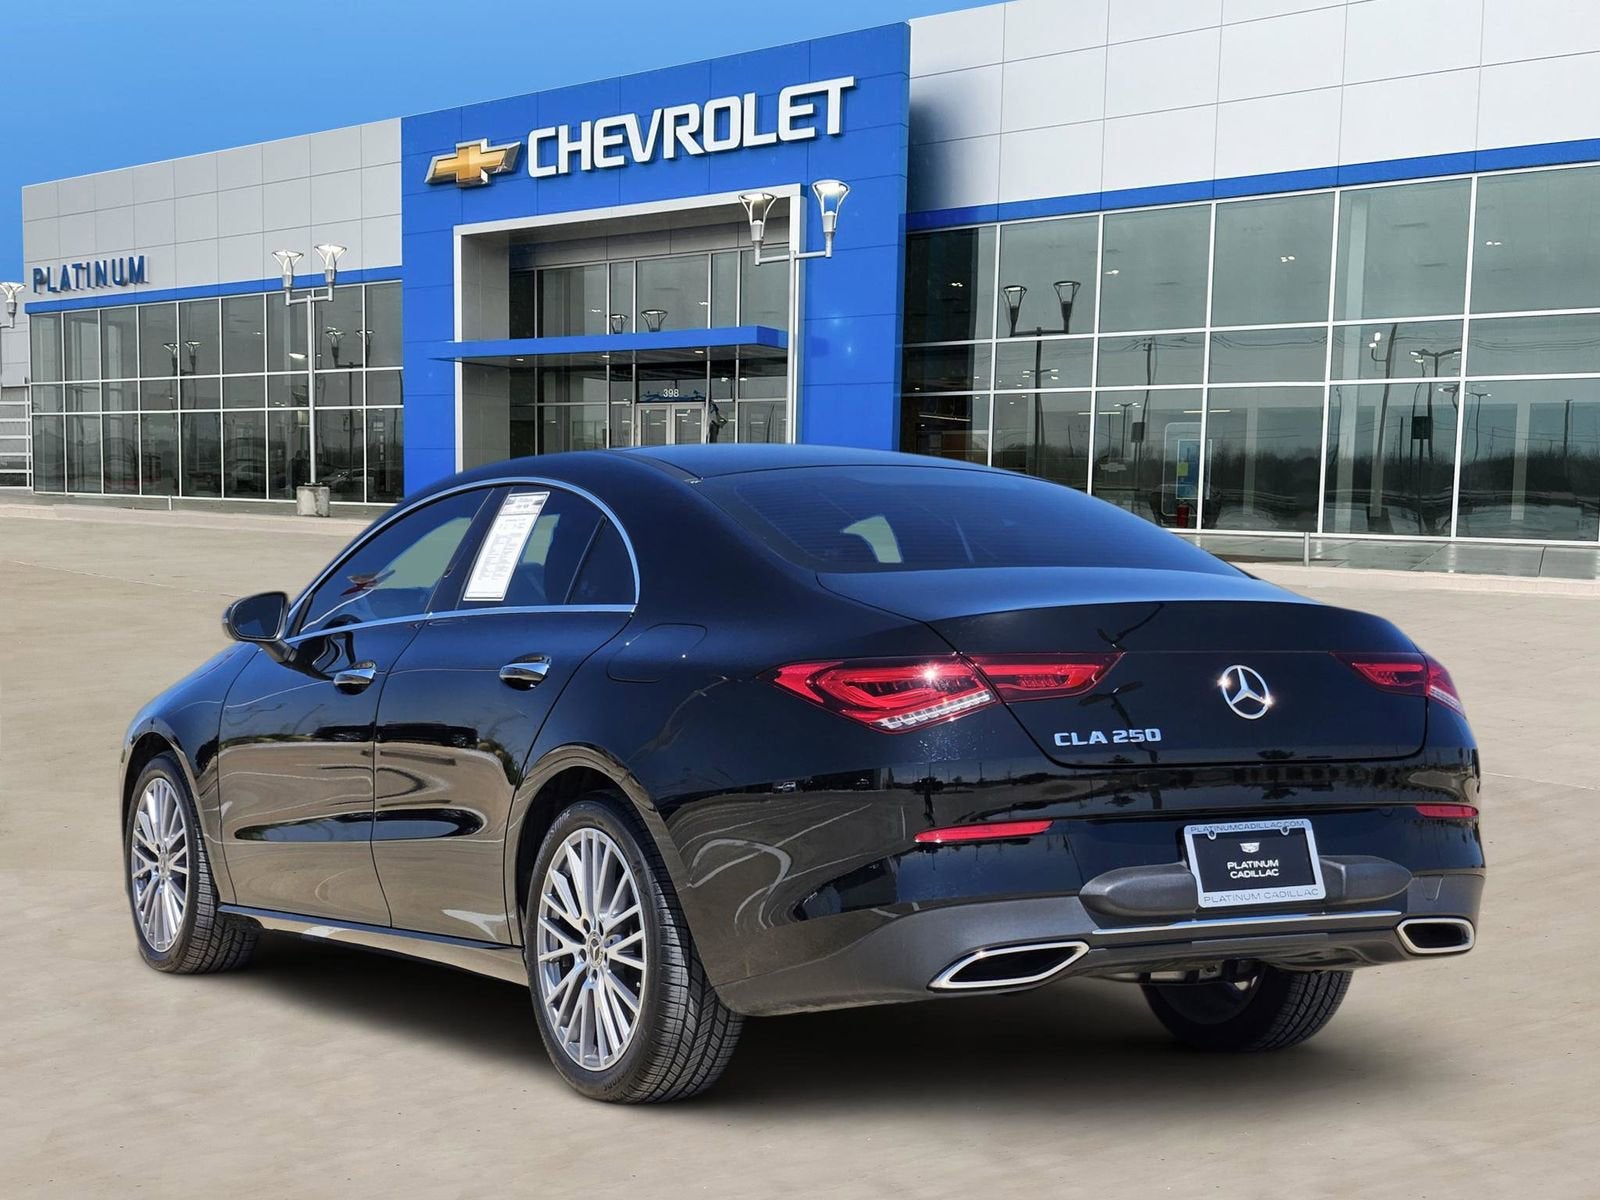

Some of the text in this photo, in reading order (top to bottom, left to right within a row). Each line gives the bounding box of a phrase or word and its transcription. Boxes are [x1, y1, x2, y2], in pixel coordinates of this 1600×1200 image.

[528, 75, 855, 178] CHEVROLET
[32, 255, 147, 294] PLATINUM
[663, 388, 679, 398] 398
[1053, 728, 1162, 747] CLA 250
[1227, 859, 1279, 870] PLATINUM
[1230, 868, 1280, 879] CADILLAC
[1204, 888, 1319, 904] PLATINUM CADILLAC
